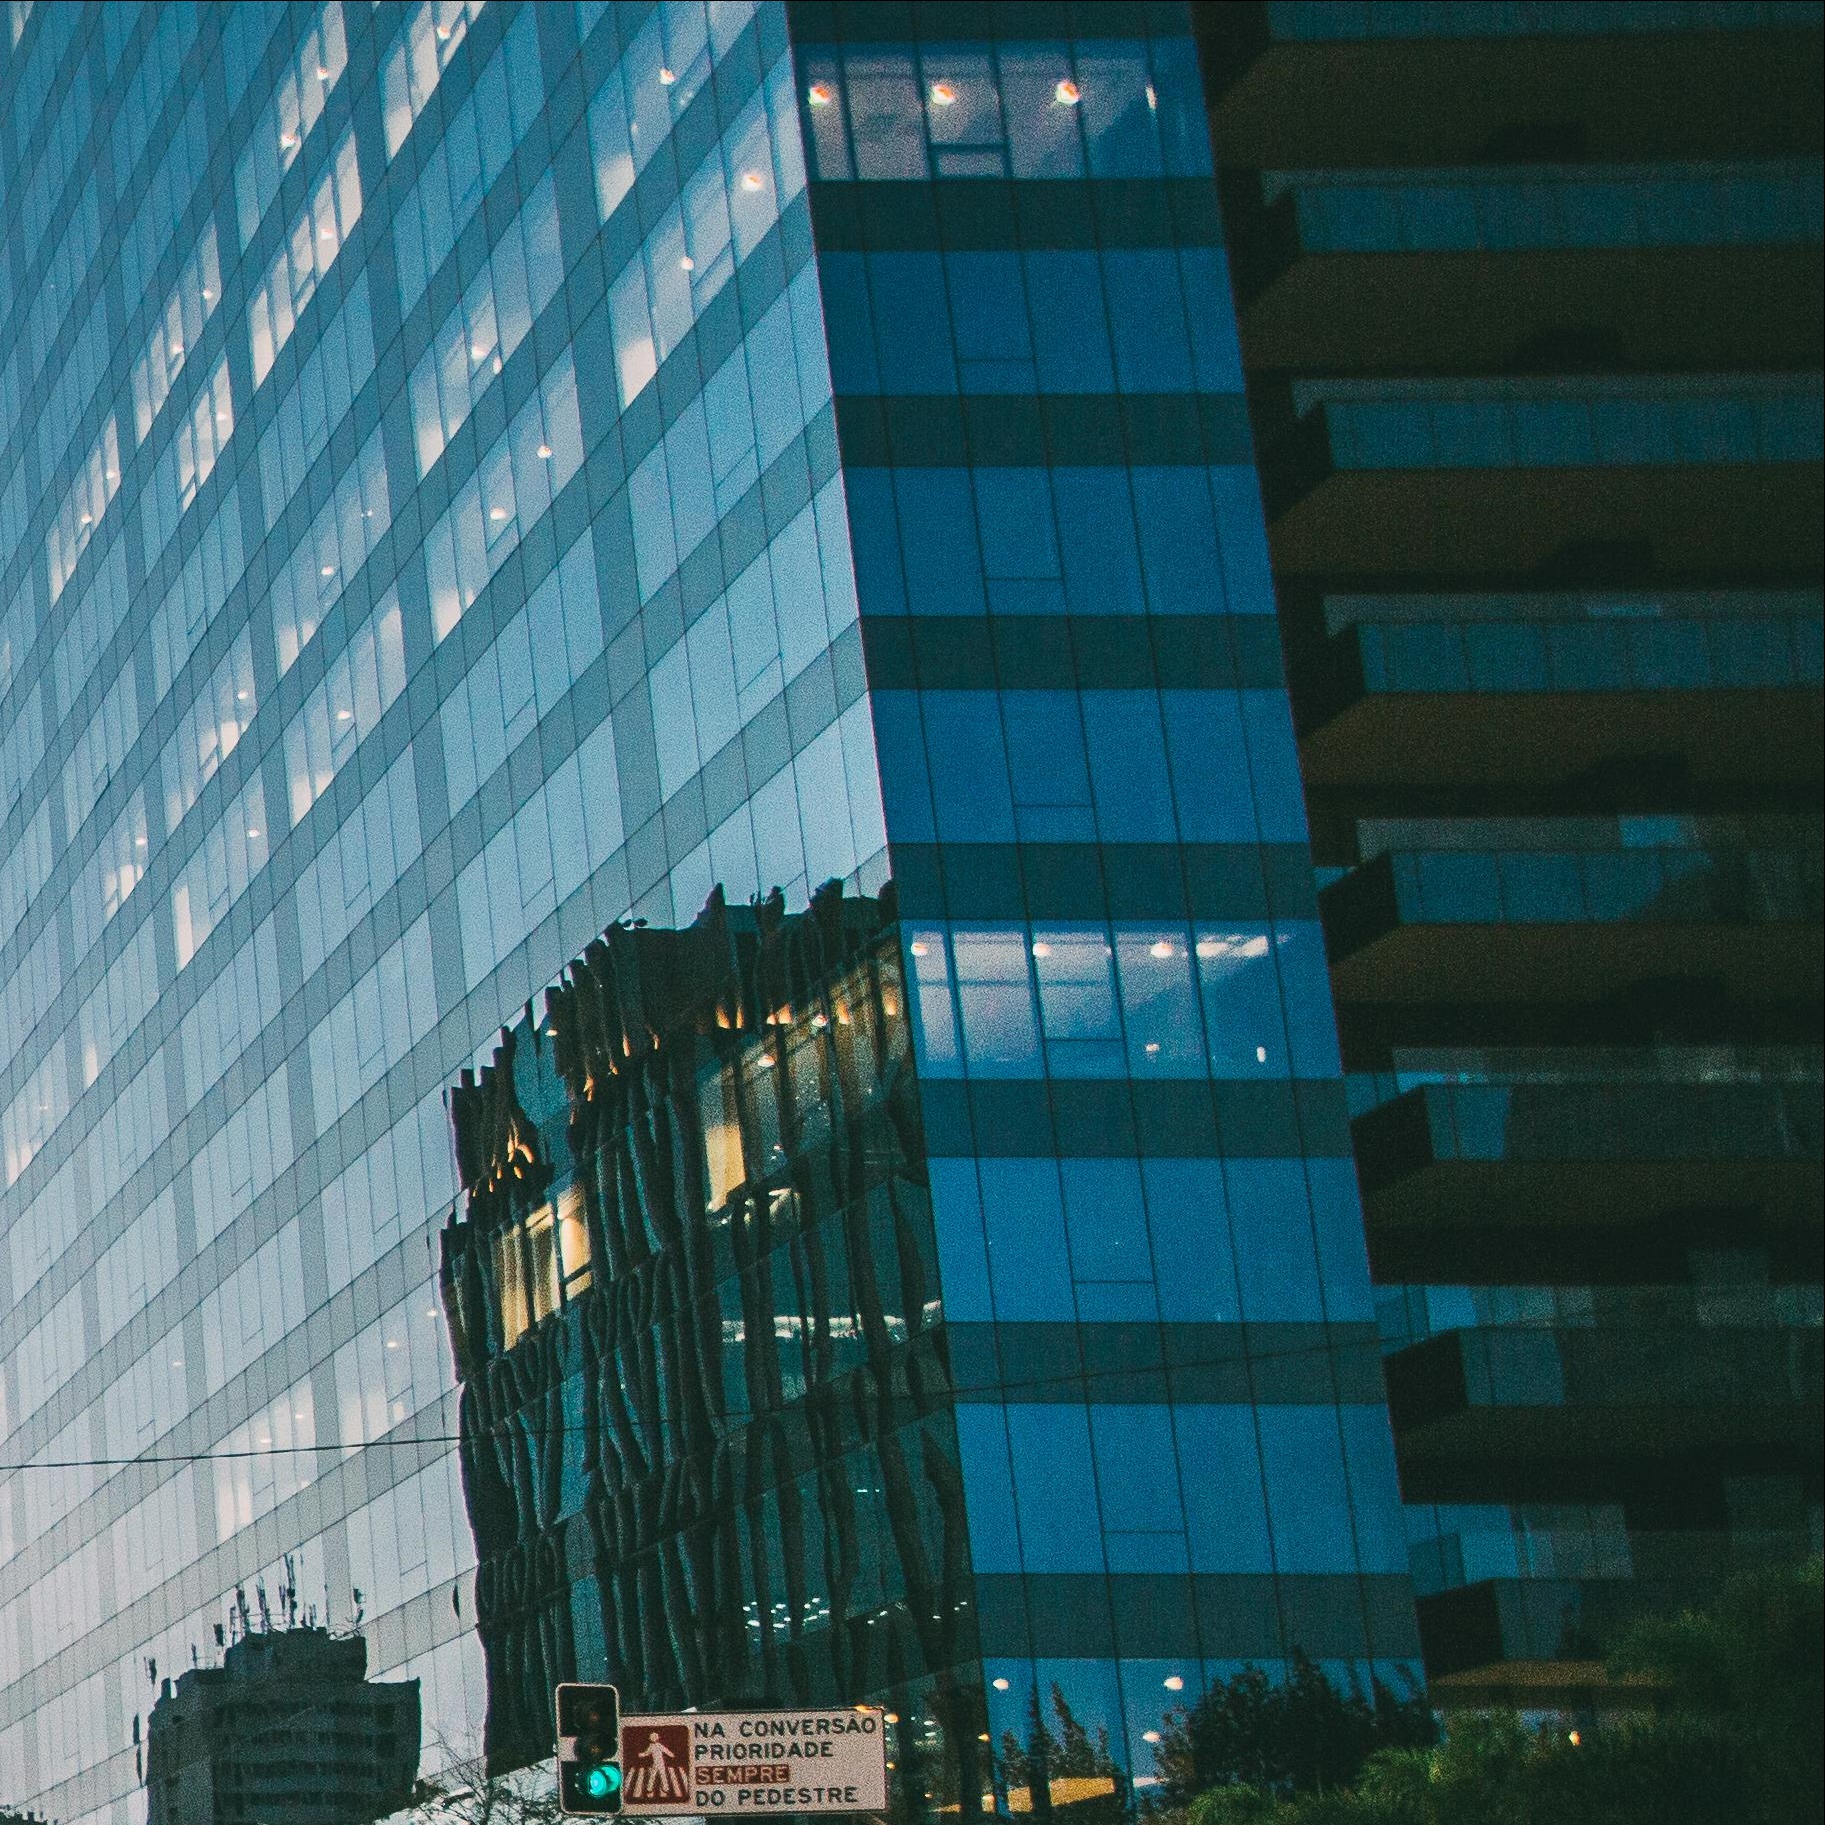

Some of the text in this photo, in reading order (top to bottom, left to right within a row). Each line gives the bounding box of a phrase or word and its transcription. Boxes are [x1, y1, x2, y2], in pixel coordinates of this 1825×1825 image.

[694, 1714, 877, 1739] NA CONVERSÃO
[694, 1741, 834, 1761] PRIORIDADE
[696, 1764, 790, 1785] SEMPRE
[695, 1785, 859, 1807] DO PEDESTRE
